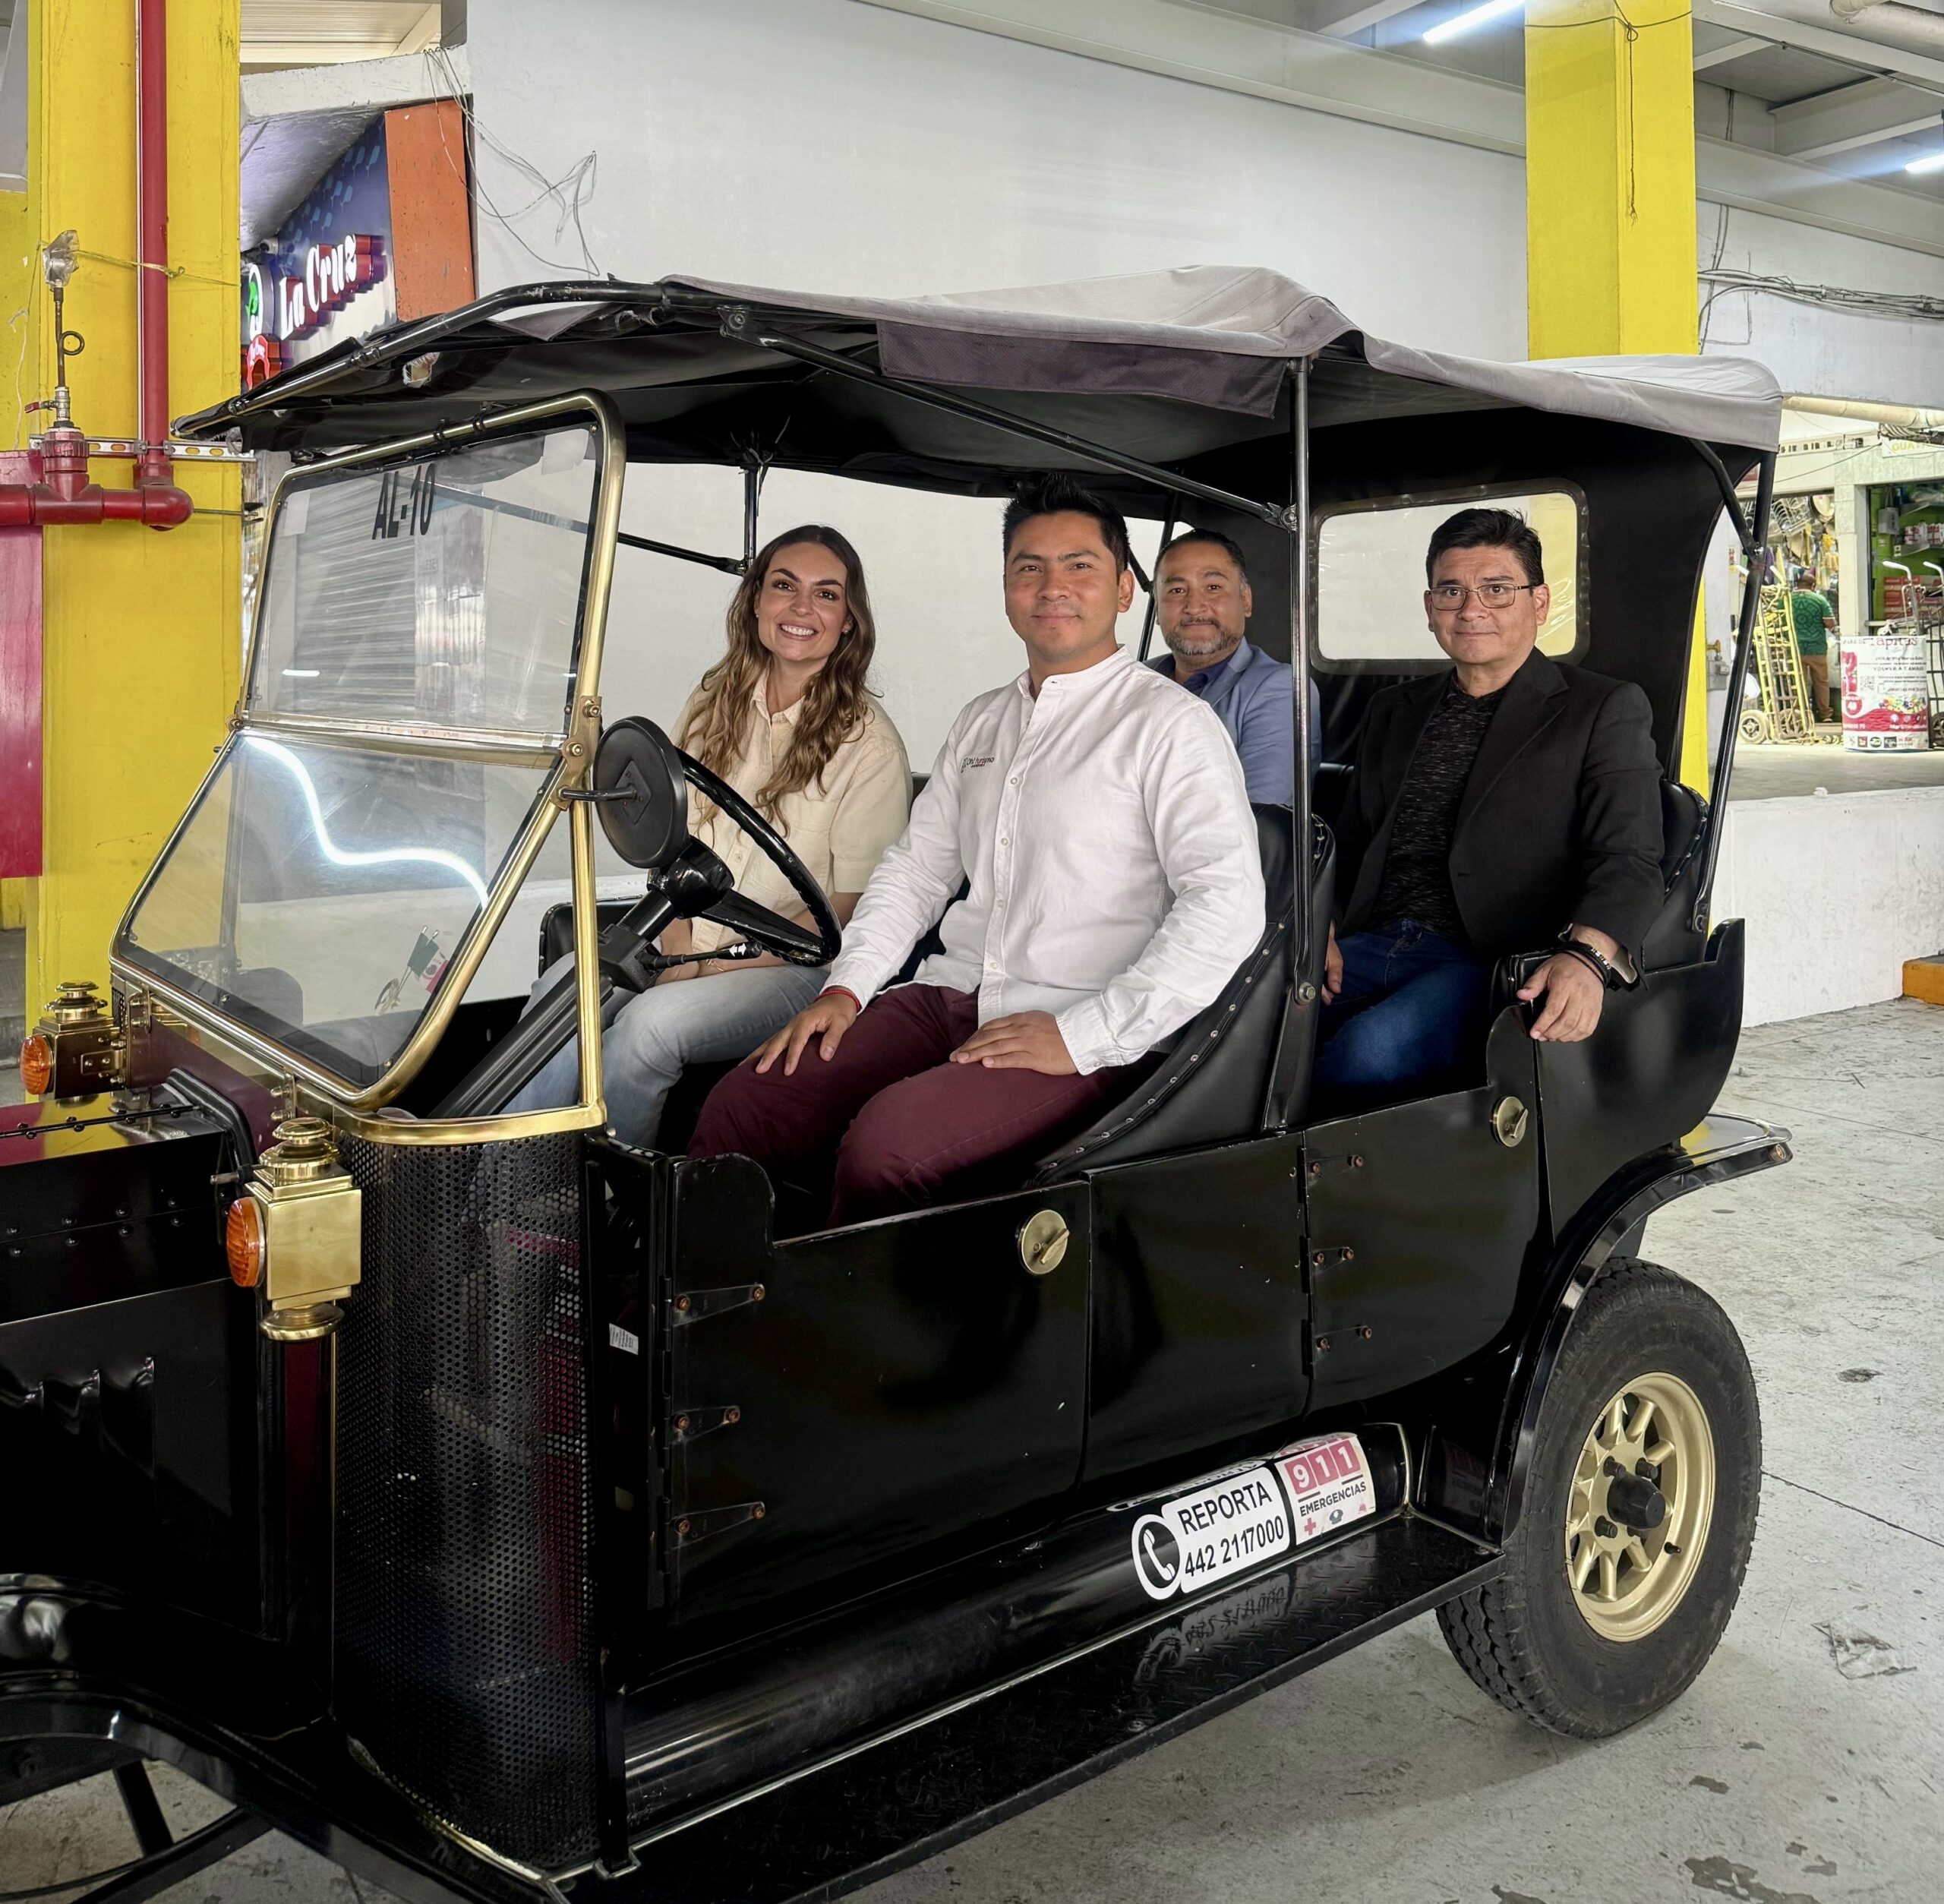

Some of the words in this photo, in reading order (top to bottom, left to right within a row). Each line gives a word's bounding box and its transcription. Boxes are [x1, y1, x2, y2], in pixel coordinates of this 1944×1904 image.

[279, 276, 305, 341] La
[306, 234, 358, 313] Cruz
[371, 463, 436, 540] AL-10
[1292, 1445, 1353, 1489] 911
[1177, 1480, 1273, 1536] REPORTA
[1299, 1482, 1367, 1517] EMERGENCIAS
[1185, 1544, 1217, 1577] 442
[1220, 1515, 1284, 1565] 2117000
